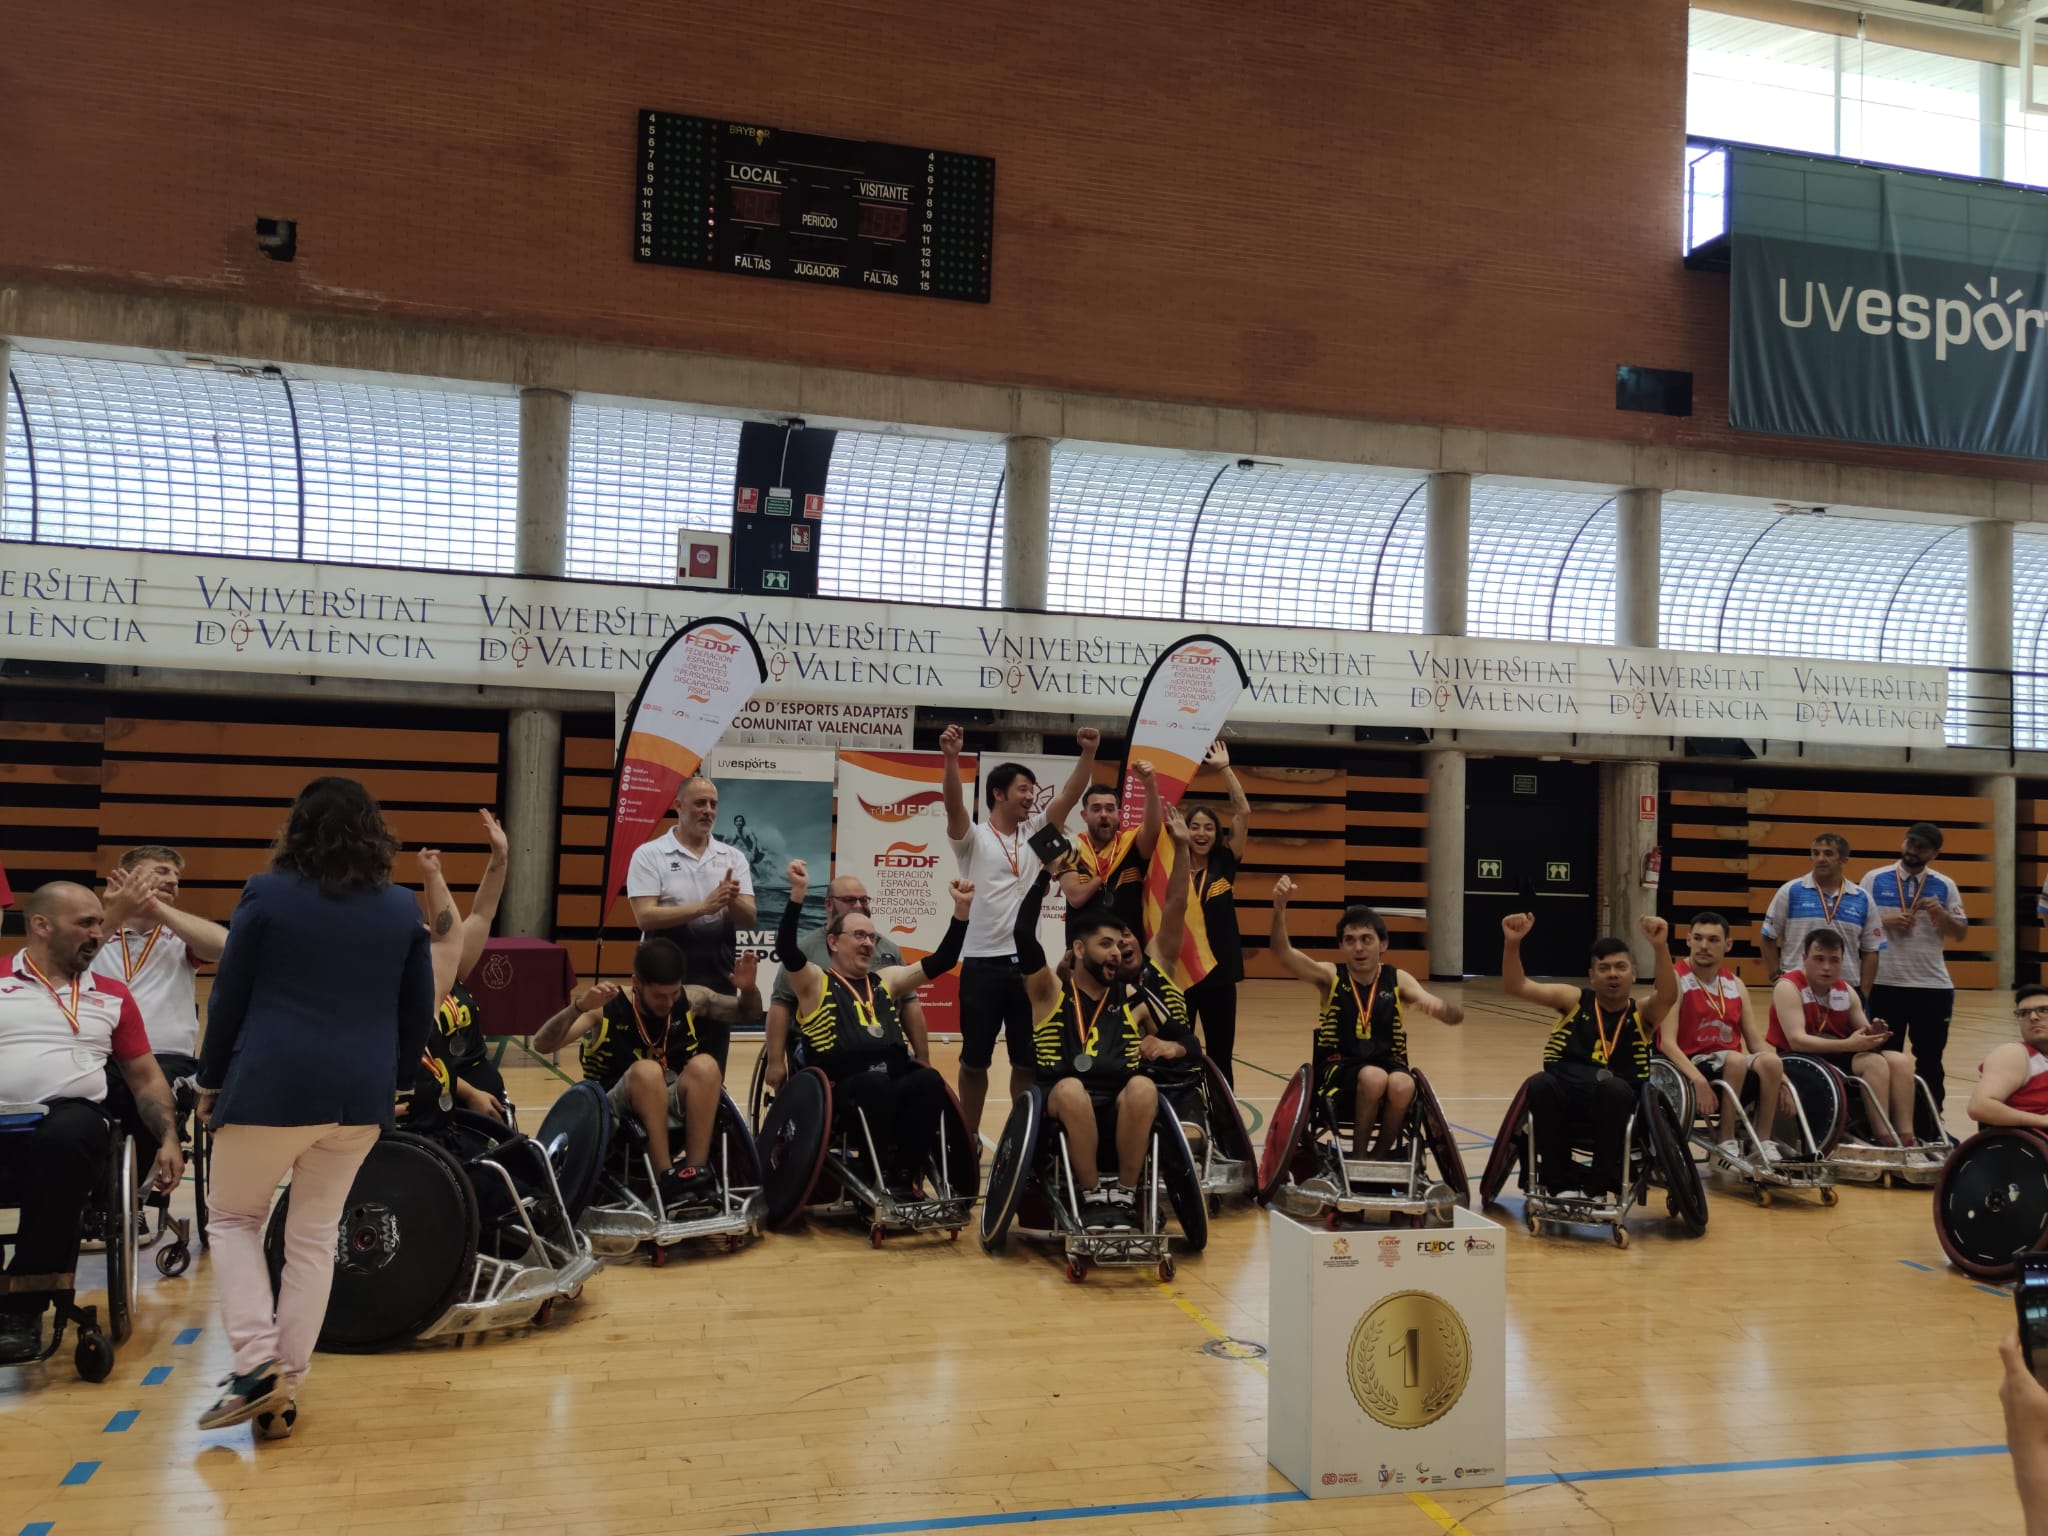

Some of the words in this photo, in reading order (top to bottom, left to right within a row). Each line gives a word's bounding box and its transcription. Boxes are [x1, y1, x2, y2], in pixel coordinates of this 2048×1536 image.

[648, 113, 656, 123] 4
[648, 125, 656, 135] 5
[648, 137, 655, 147] 6
[648, 149, 655, 159] 7
[928, 152, 935, 161] 4
[647, 161, 655, 171] 8
[927, 163, 935, 173] 5
[647, 173, 654, 183] 9
[730, 165, 782, 185] LOCAL
[927, 175, 934, 184] 6
[642, 186, 654, 197] 10
[859, 182, 909, 200] VISITANTE
[927, 186, 934, 196] 7
[642, 199, 651, 209] 11
[926, 198, 933, 208] 8
[642, 211, 653, 222] 12
[926, 210, 933, 219] 9
[801, 213, 838, 229] PERIODO
[641, 223, 652, 233] 13
[922, 223, 932, 233] 10
[640, 235, 652, 245] 14
[922, 235, 930, 245] 11
[640, 247, 651, 257] 15
[920, 247, 932, 257] 12
[734, 255, 771, 271] FALTAS
[920, 258, 931, 268] 13
[794, 263, 840, 279] JUGADOR
[920, 270, 930, 279] 14
[863, 271, 899, 286] FALTAS
[919, 281, 930, 291] 15
[1779, 276, 2048, 360] UVespor
[196, 575, 435, 623] VNIVERSITAT
[257, 619, 436, 660] VALÈNCIA
[685, 634, 741, 655] FEDDF
[1171, 654, 1221, 666] FEDDF
[1241, 647, 1376, 676] IVERSITAT
[793, 651, 943, 687] VALÈNCIA
[1409, 650, 1576, 684] VNIVERSITAT
[1608, 658, 1765, 691] VNIVERSITAT
[1793, 667, 1945, 701] VNIVERSITAT
[1248, 676, 1378, 708] VALÈNCIA
[1452, 684, 1578, 714] VALÈNCIA
[1649, 691, 1769, 721] VALÈNCIA
[843, 705, 909, 720] ADAPTATS
[731, 716, 813, 732] COMUNITAT
[817, 720, 904, 736] VALENCIANA
[874, 854, 940, 868] FEDDF
[884, 888, 932, 897] DEPORTES
[876, 897, 925, 907] PERSONAS
[870, 906, 937, 916] DISCAPACIDAD
[1388, 1328, 1419, 1388] 1
